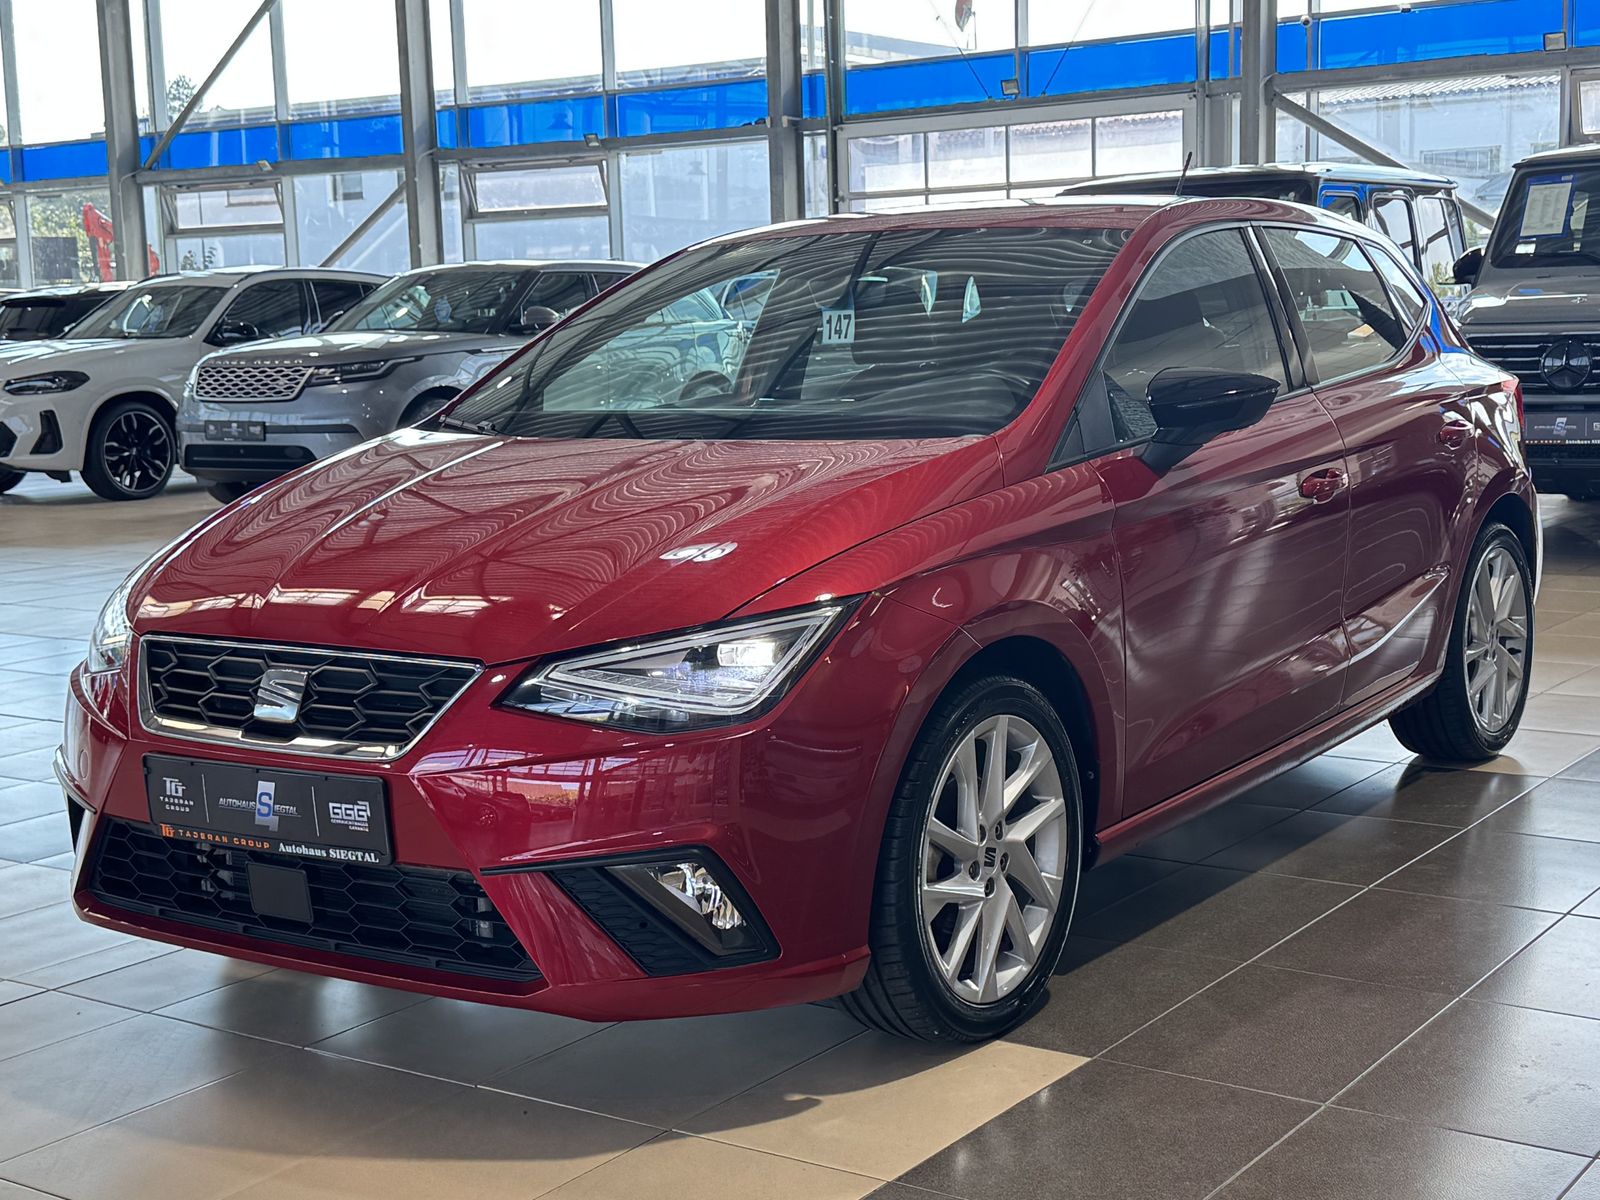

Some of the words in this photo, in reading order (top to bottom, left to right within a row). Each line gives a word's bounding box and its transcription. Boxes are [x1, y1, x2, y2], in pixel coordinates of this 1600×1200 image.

[826, 314, 852, 340] 147
[219, 797, 256, 810] AUTOHAUS
[232, 837, 270, 849] GROUP
[279, 842, 327, 857] Autohaus
[329, 848, 379, 863] SIEGTAL
